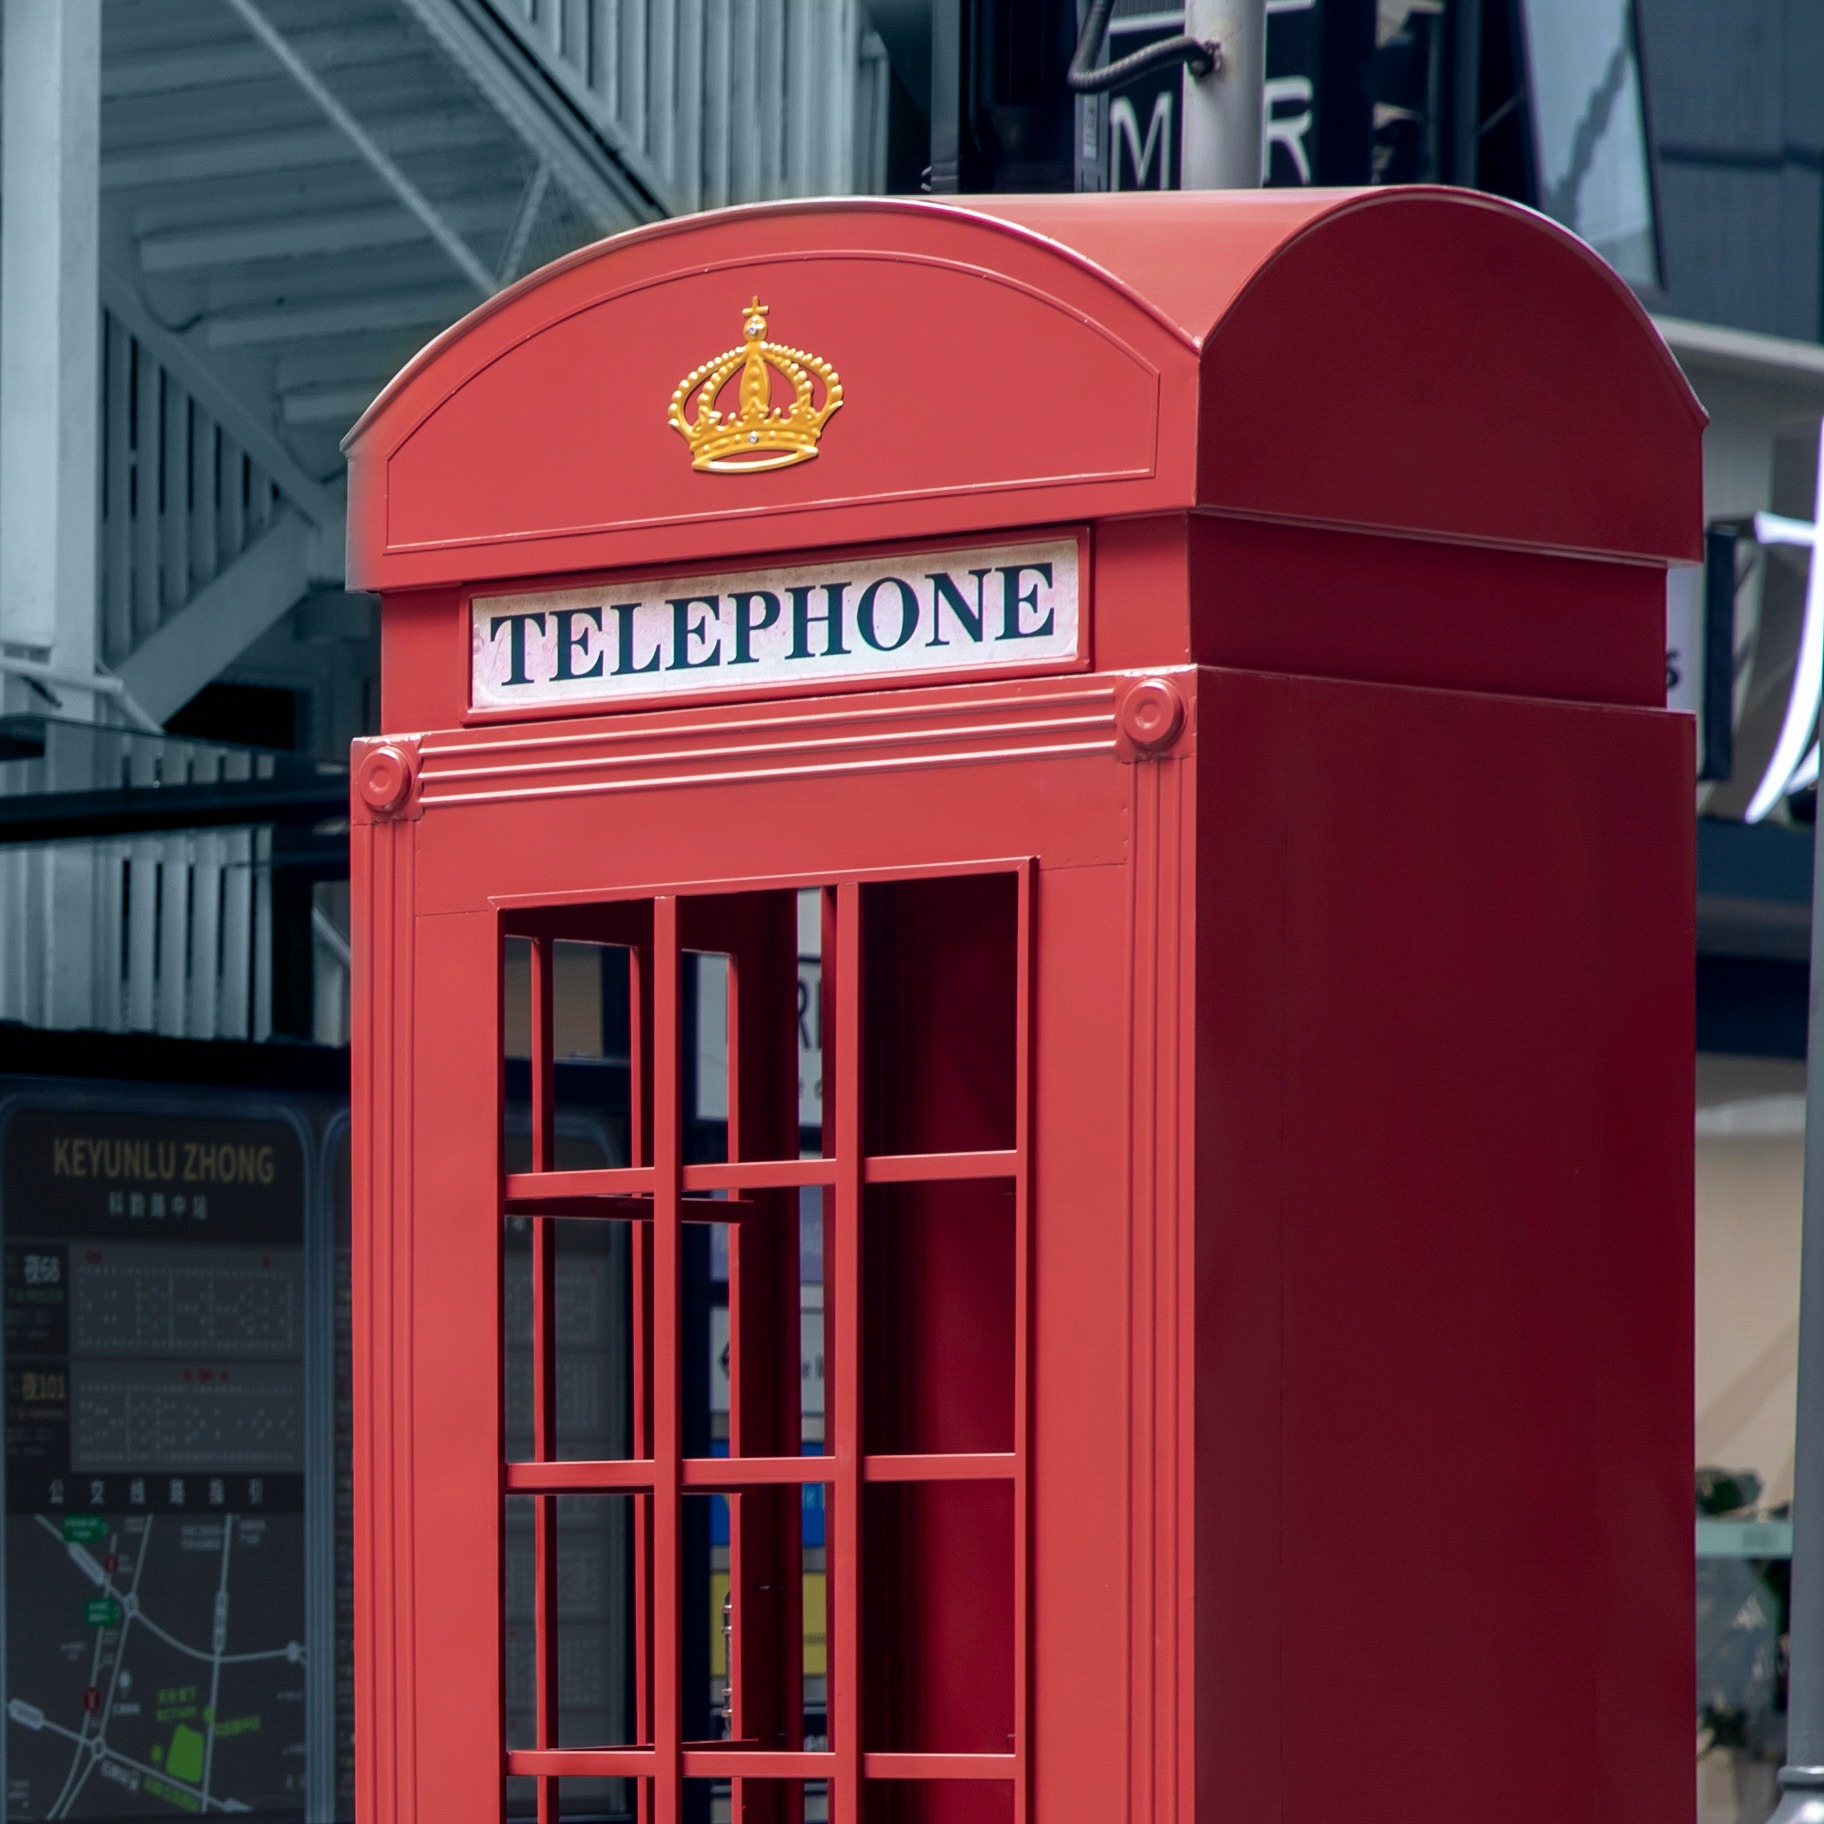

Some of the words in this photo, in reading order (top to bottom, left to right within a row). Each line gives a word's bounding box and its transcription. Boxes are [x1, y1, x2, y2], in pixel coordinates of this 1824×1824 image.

[1109, 76, 1313, 192] MR
[489, 561, 1054, 687] TELEPHONE
[54, 1138, 176, 1180] KEYUNLU
[182, 1142, 275, 1184] ZHONG
